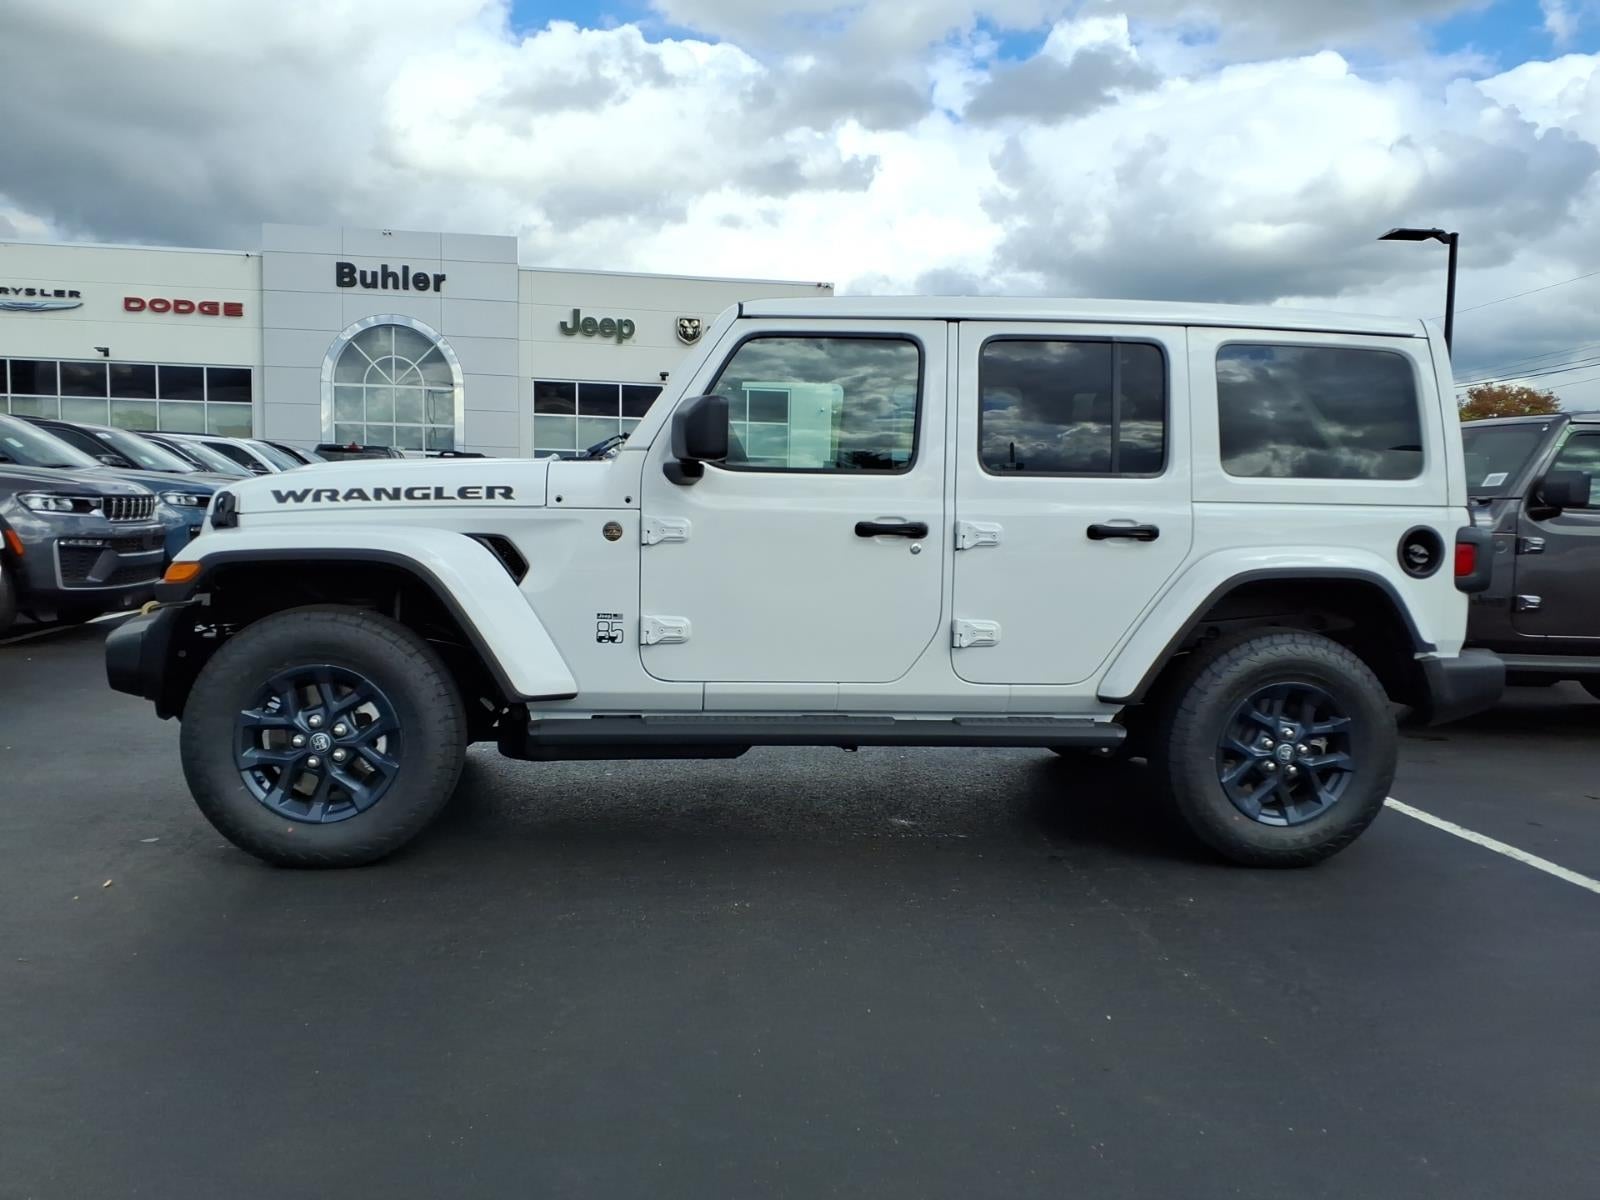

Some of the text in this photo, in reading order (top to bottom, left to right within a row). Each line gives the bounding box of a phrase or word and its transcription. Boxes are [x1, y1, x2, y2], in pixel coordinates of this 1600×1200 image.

[336, 261, 447, 293] Buhler
[124, 297, 244, 317] DODGE
[559, 308, 636, 344] Jeep
[270, 485, 516, 504] WRANGLER
[596, 621, 623, 643] 85
